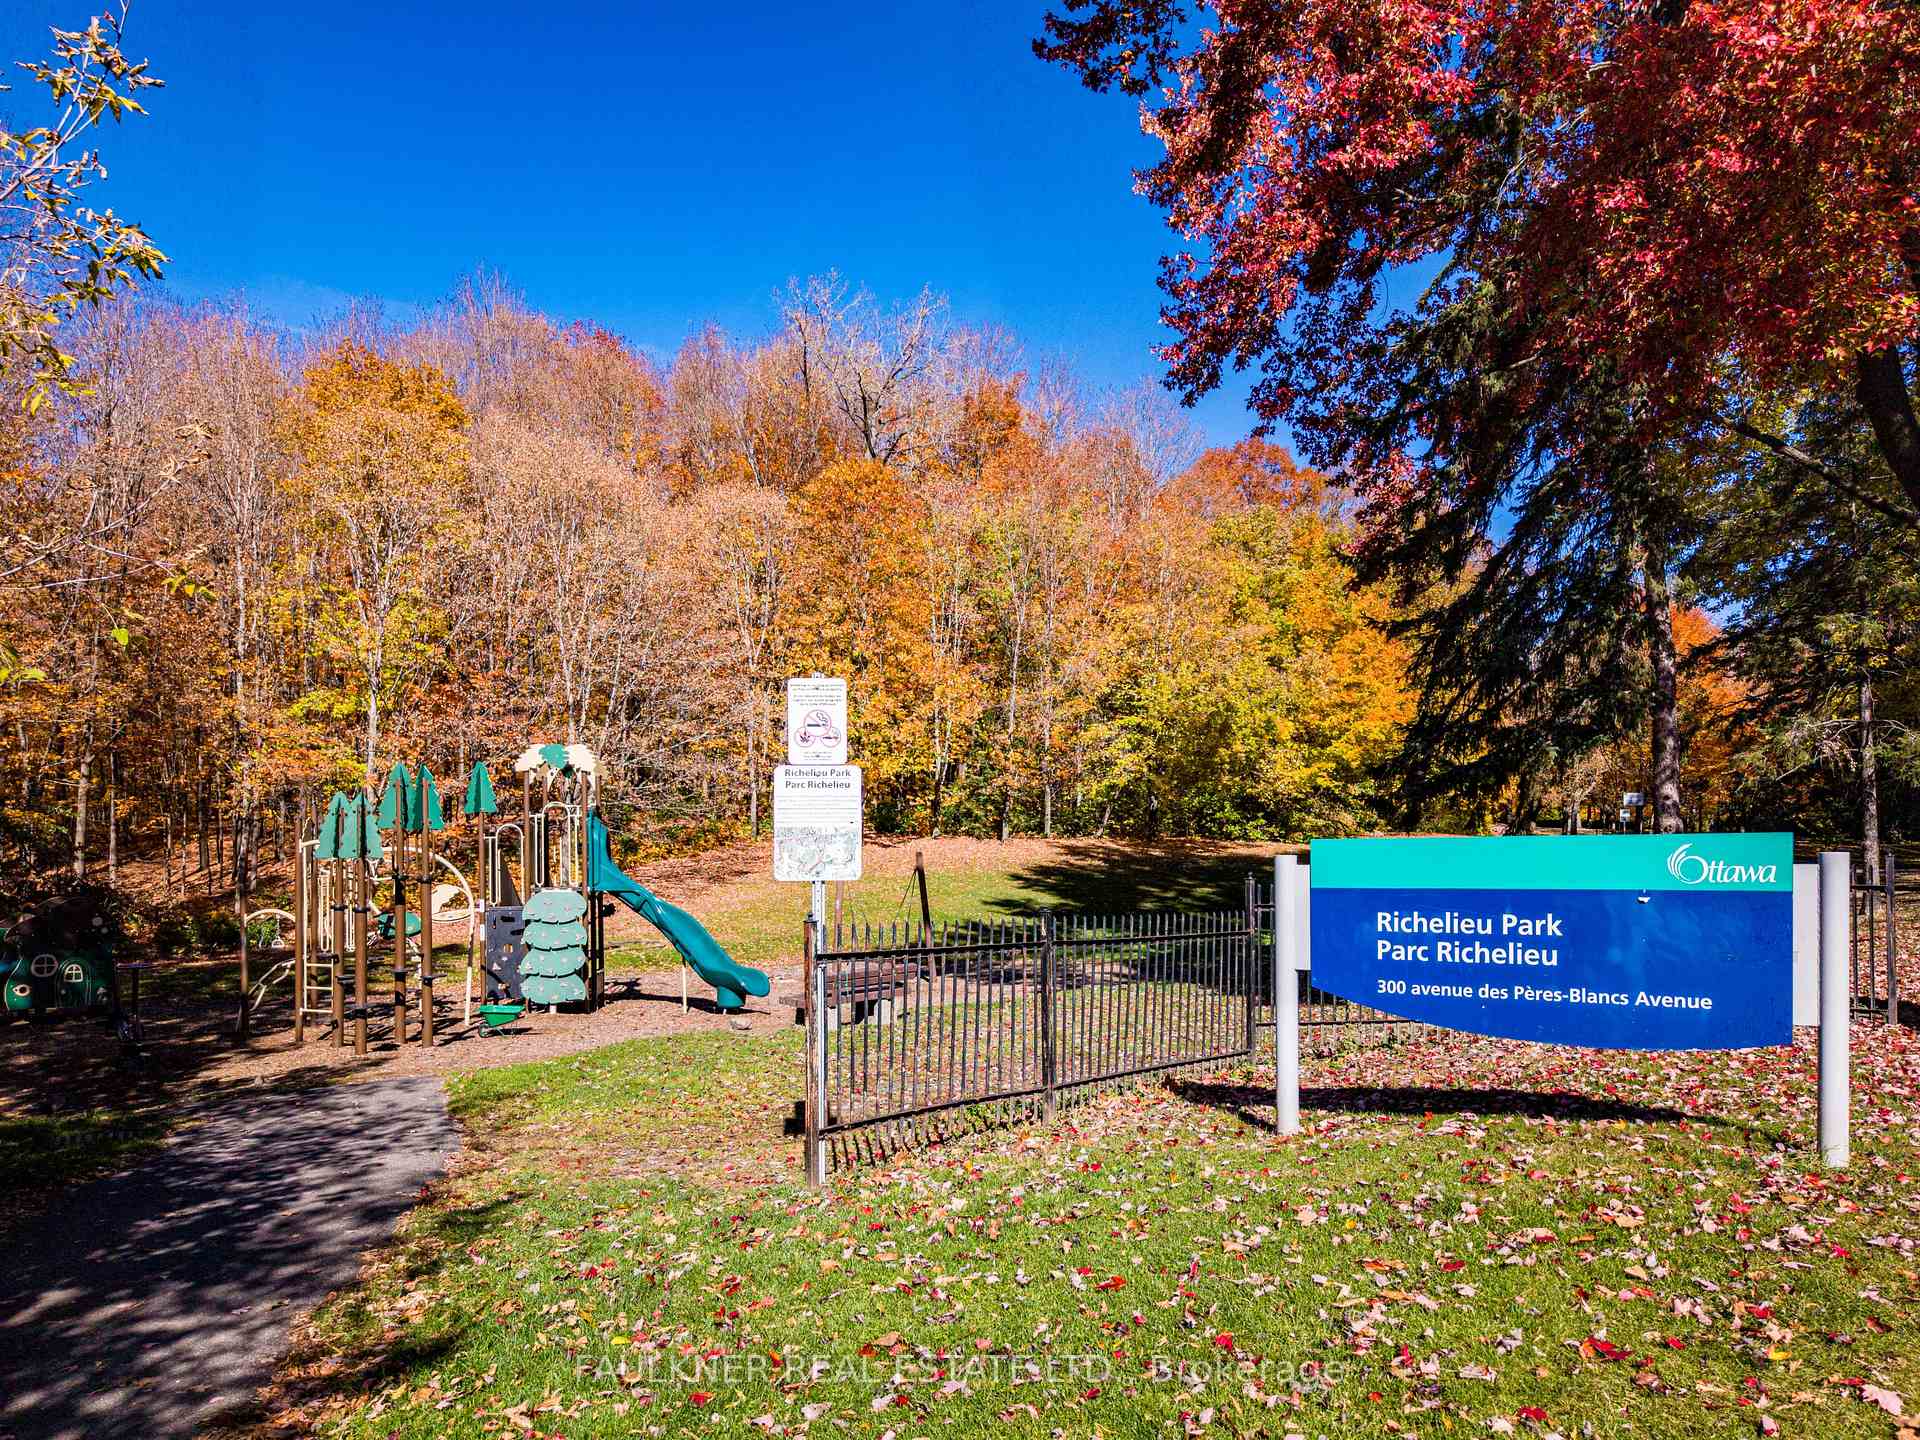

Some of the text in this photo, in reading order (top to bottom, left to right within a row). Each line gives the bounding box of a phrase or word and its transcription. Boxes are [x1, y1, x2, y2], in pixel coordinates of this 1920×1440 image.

[785, 780, 851, 789] Parc Richelieu
[830, 768, 852, 777] Park
[1667, 843, 1776, 884] Ottawa
[1377, 911, 1563, 936] Richelieu Park
[1377, 940, 1558, 966] Parc Richelieu
[1377, 979, 1713, 1010] 300 avenue des Pères-Blancs Avenue
